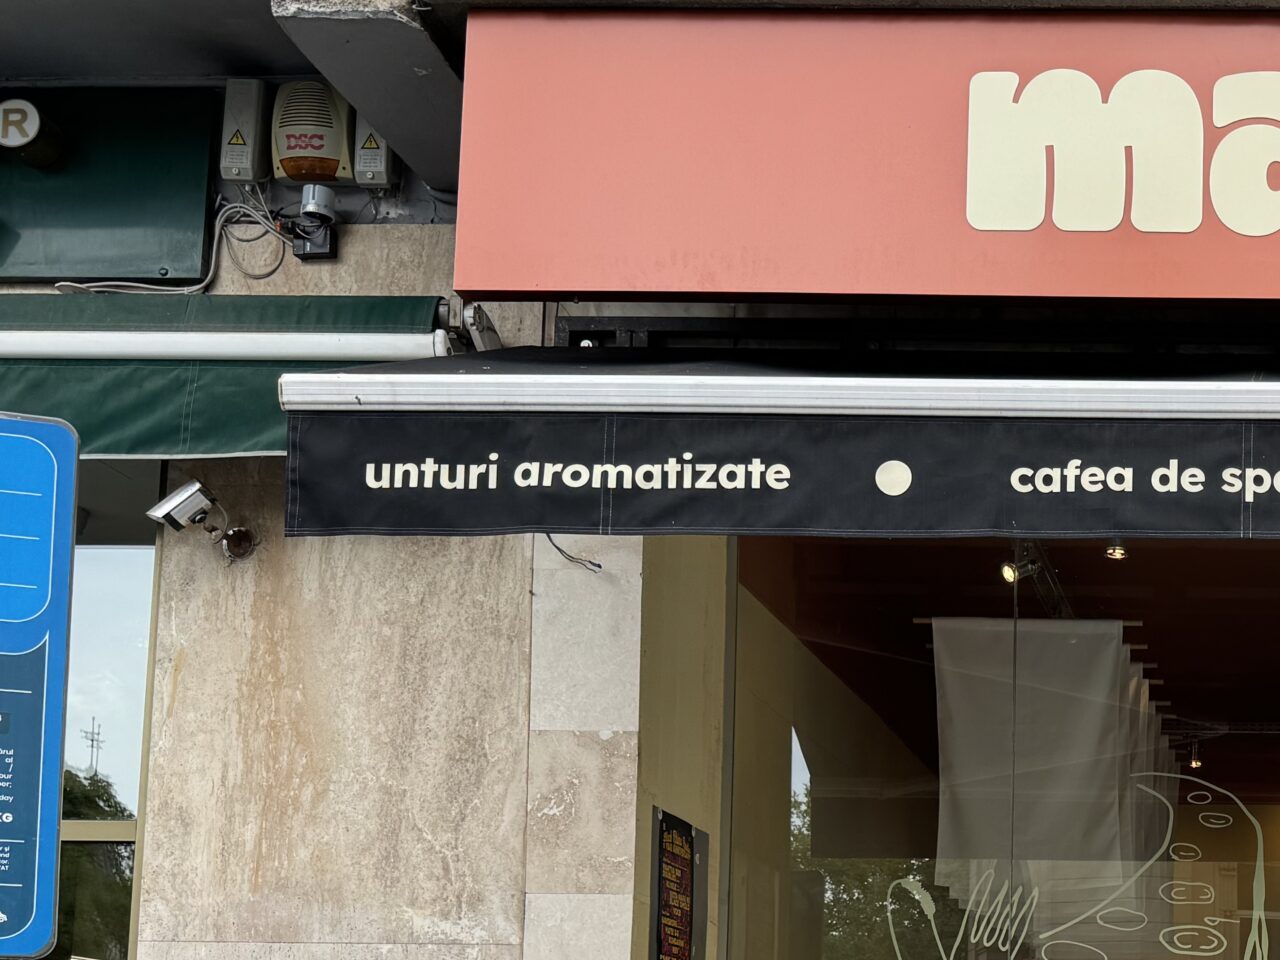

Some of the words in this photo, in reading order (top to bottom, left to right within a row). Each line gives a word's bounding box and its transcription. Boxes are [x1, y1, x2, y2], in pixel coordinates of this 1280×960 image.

[285, 133, 325, 151] DSC
[365, 452, 499, 489] unturi
[513, 451, 791, 490] aromatizate
[1010, 458, 1134, 493] cafea
[1150, 458, 1206, 493] de
